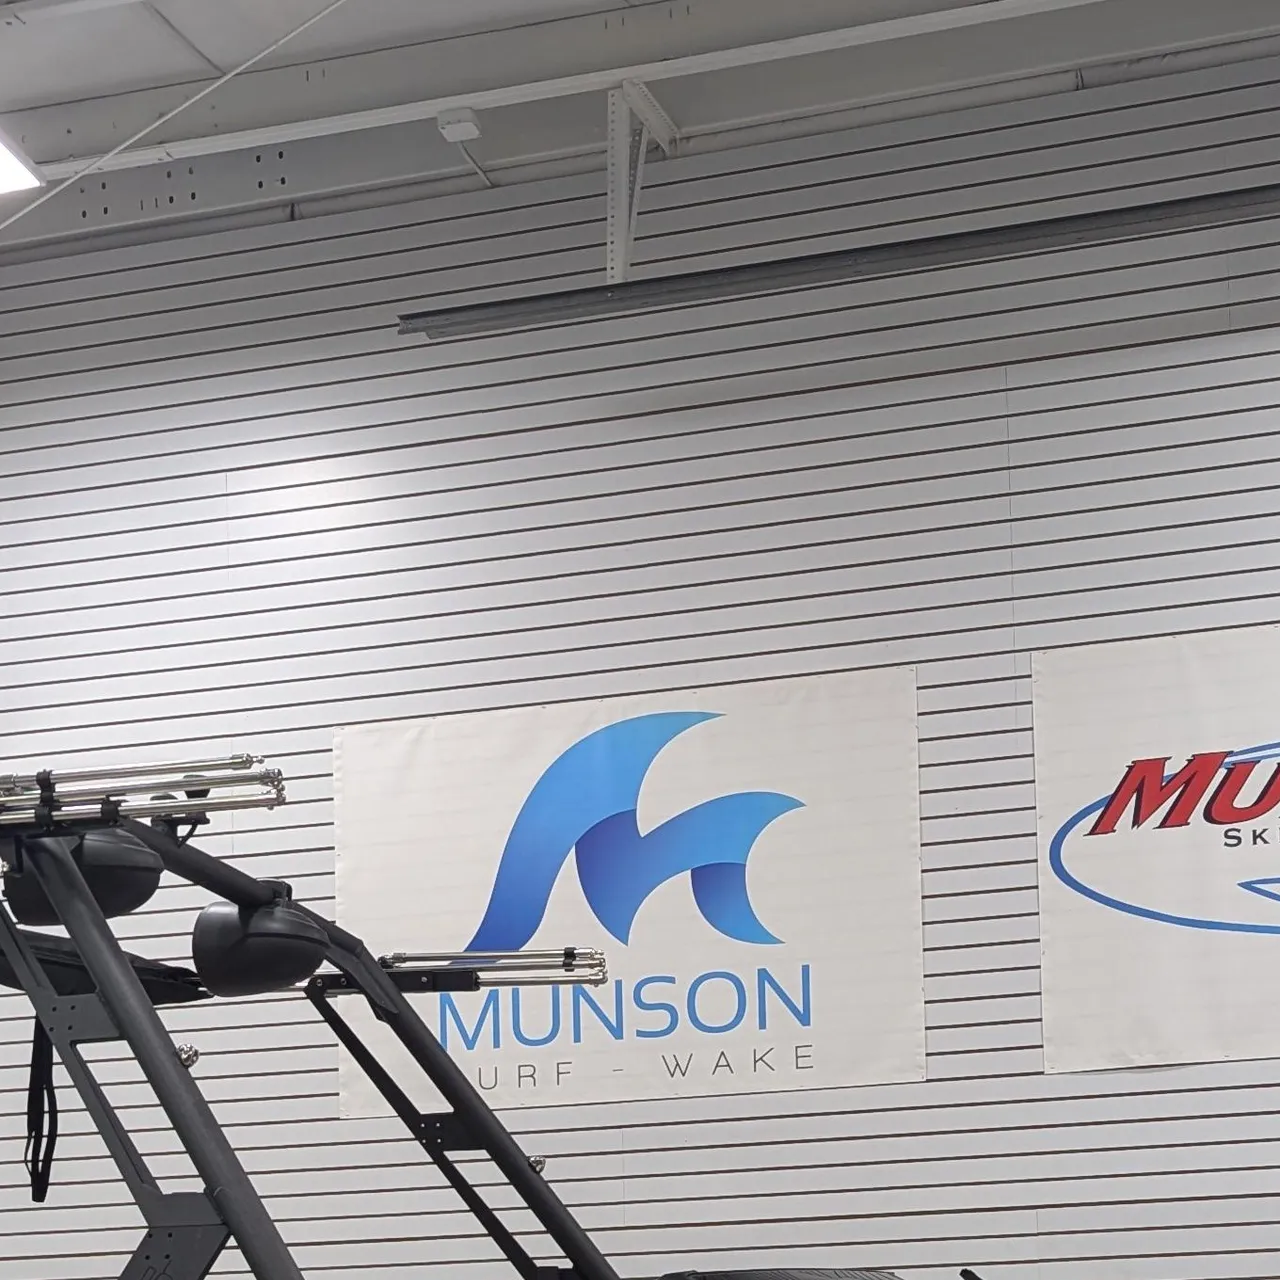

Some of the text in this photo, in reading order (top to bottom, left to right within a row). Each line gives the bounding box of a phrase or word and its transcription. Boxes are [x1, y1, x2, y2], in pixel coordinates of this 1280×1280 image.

[439, 963, 812, 1051] MUNSON
[477, 1061, 574, 1091] URF
[661, 1043, 815, 1079] WAKE
